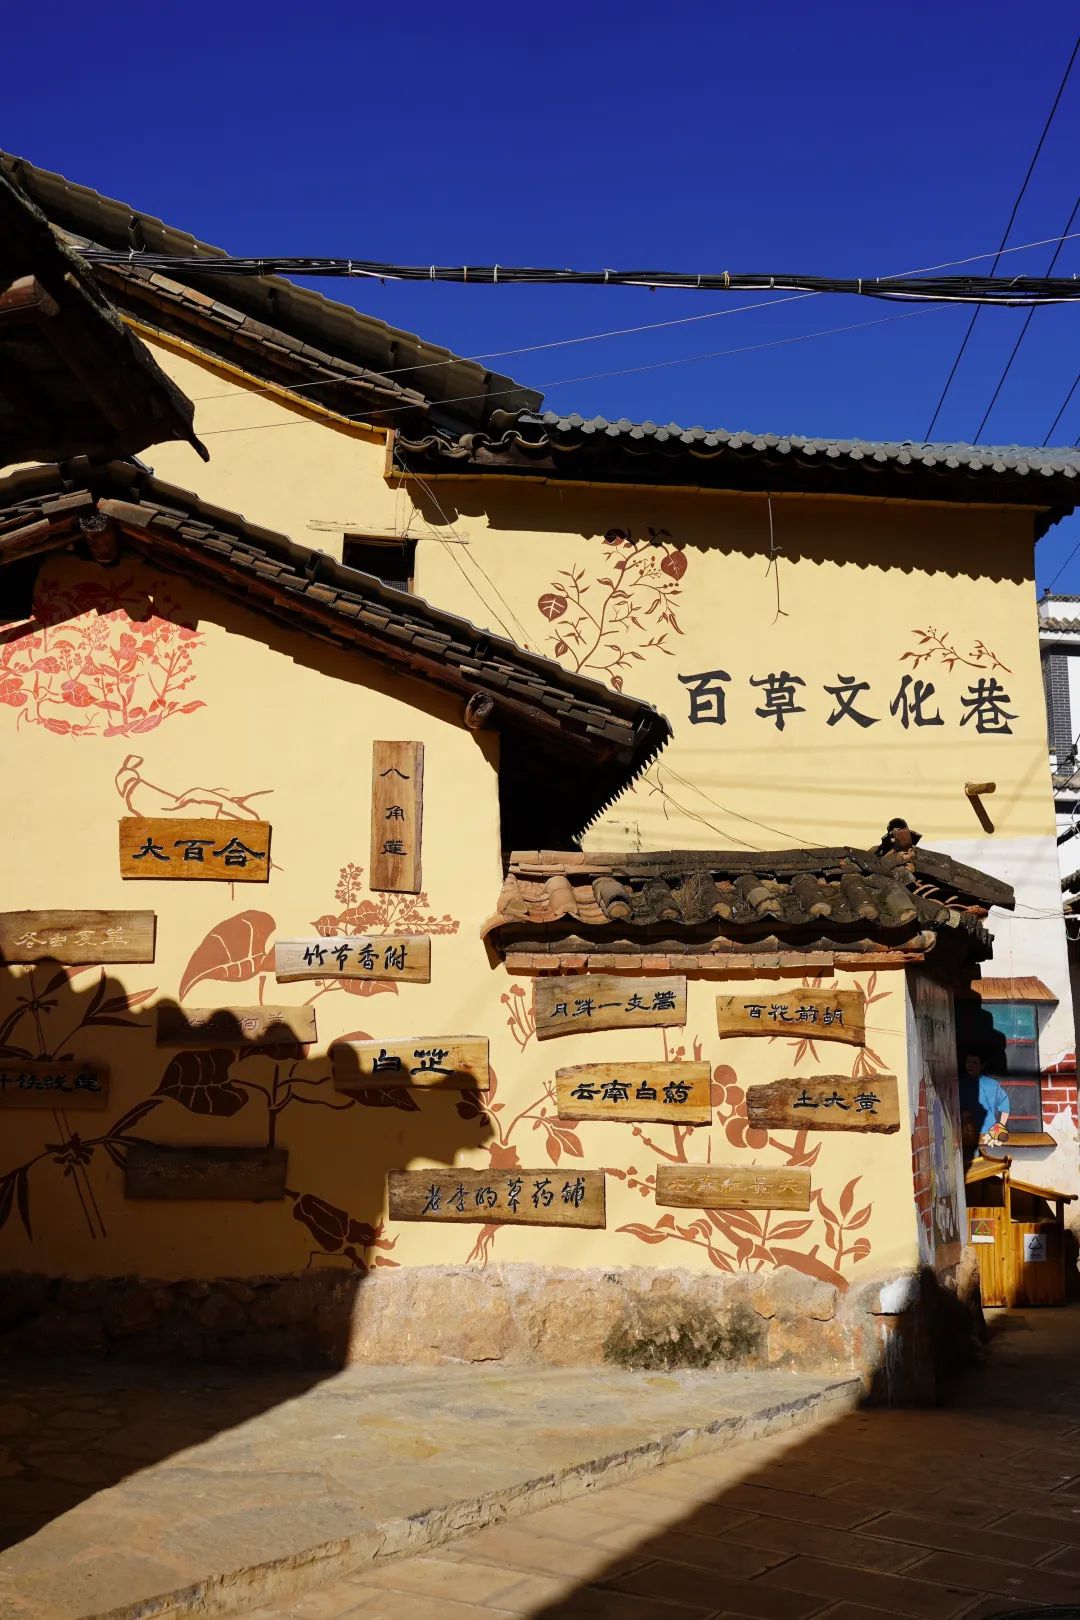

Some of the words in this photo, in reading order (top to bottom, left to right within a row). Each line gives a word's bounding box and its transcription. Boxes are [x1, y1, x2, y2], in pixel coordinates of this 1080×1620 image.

[677, 669, 1019, 735] 百草文化巷
[132, 837, 266, 867] 大百合
[14, 926, 129, 949] 冬虫夏草
[302, 943, 408, 972] 竹节香附
[743, 1003, 845, 1027] 百花前胡
[372, 1048, 455, 1076] 白芷
[570, 1079, 693, 1104] 云南白药
[793, 1090, 881, 1114] 土大黄
